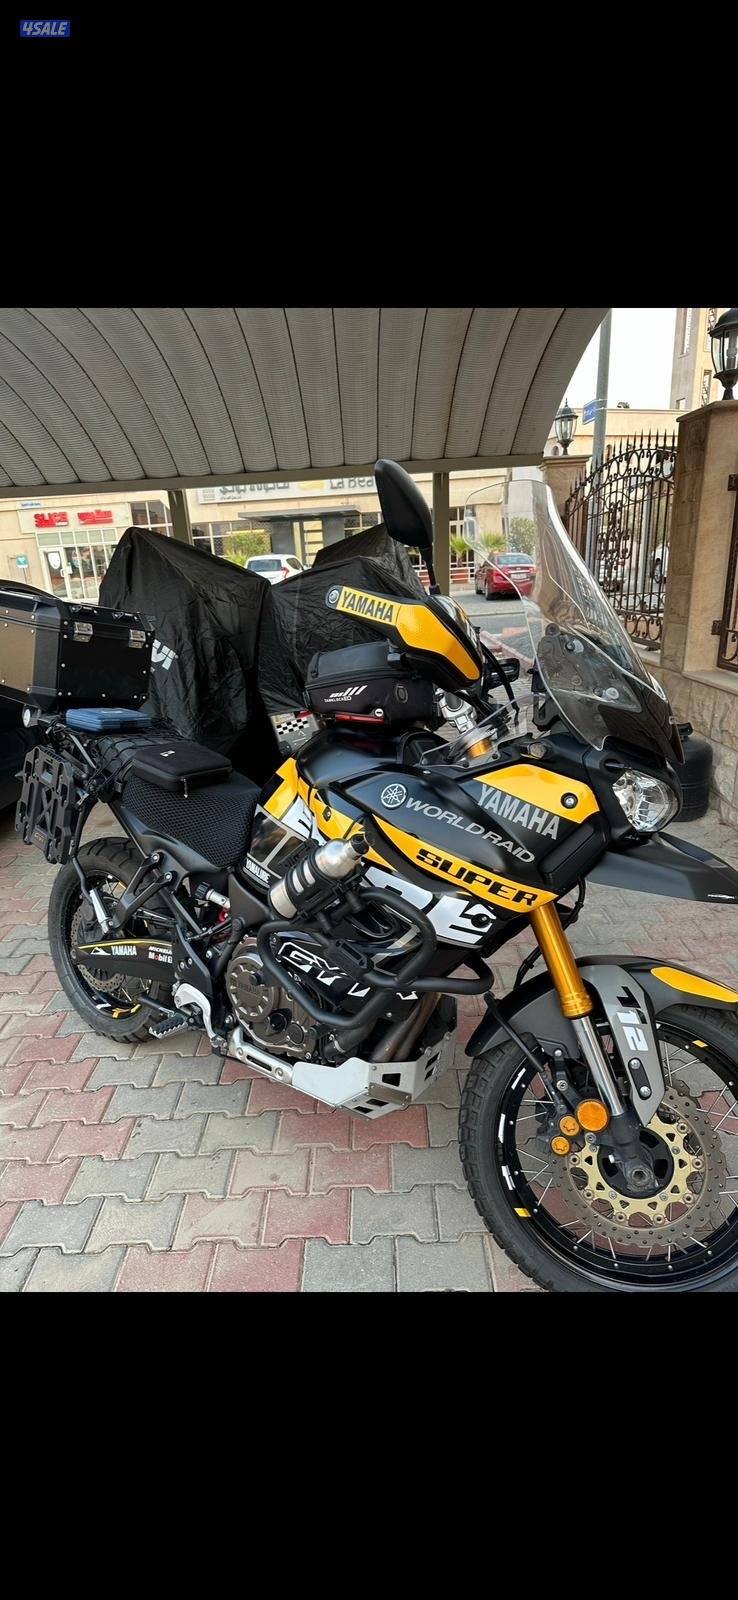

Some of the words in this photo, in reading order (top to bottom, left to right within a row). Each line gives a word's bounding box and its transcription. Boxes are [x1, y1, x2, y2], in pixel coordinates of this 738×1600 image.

[343, 590, 395, 623] YAMAHA
[405, 797, 485, 835] WORLD
[482, 830, 535, 863] RAID
[477, 784, 561, 840] YAMAHA
[416, 848, 539, 906] SUPER
[111, 945, 137, 956] YAMAHA
